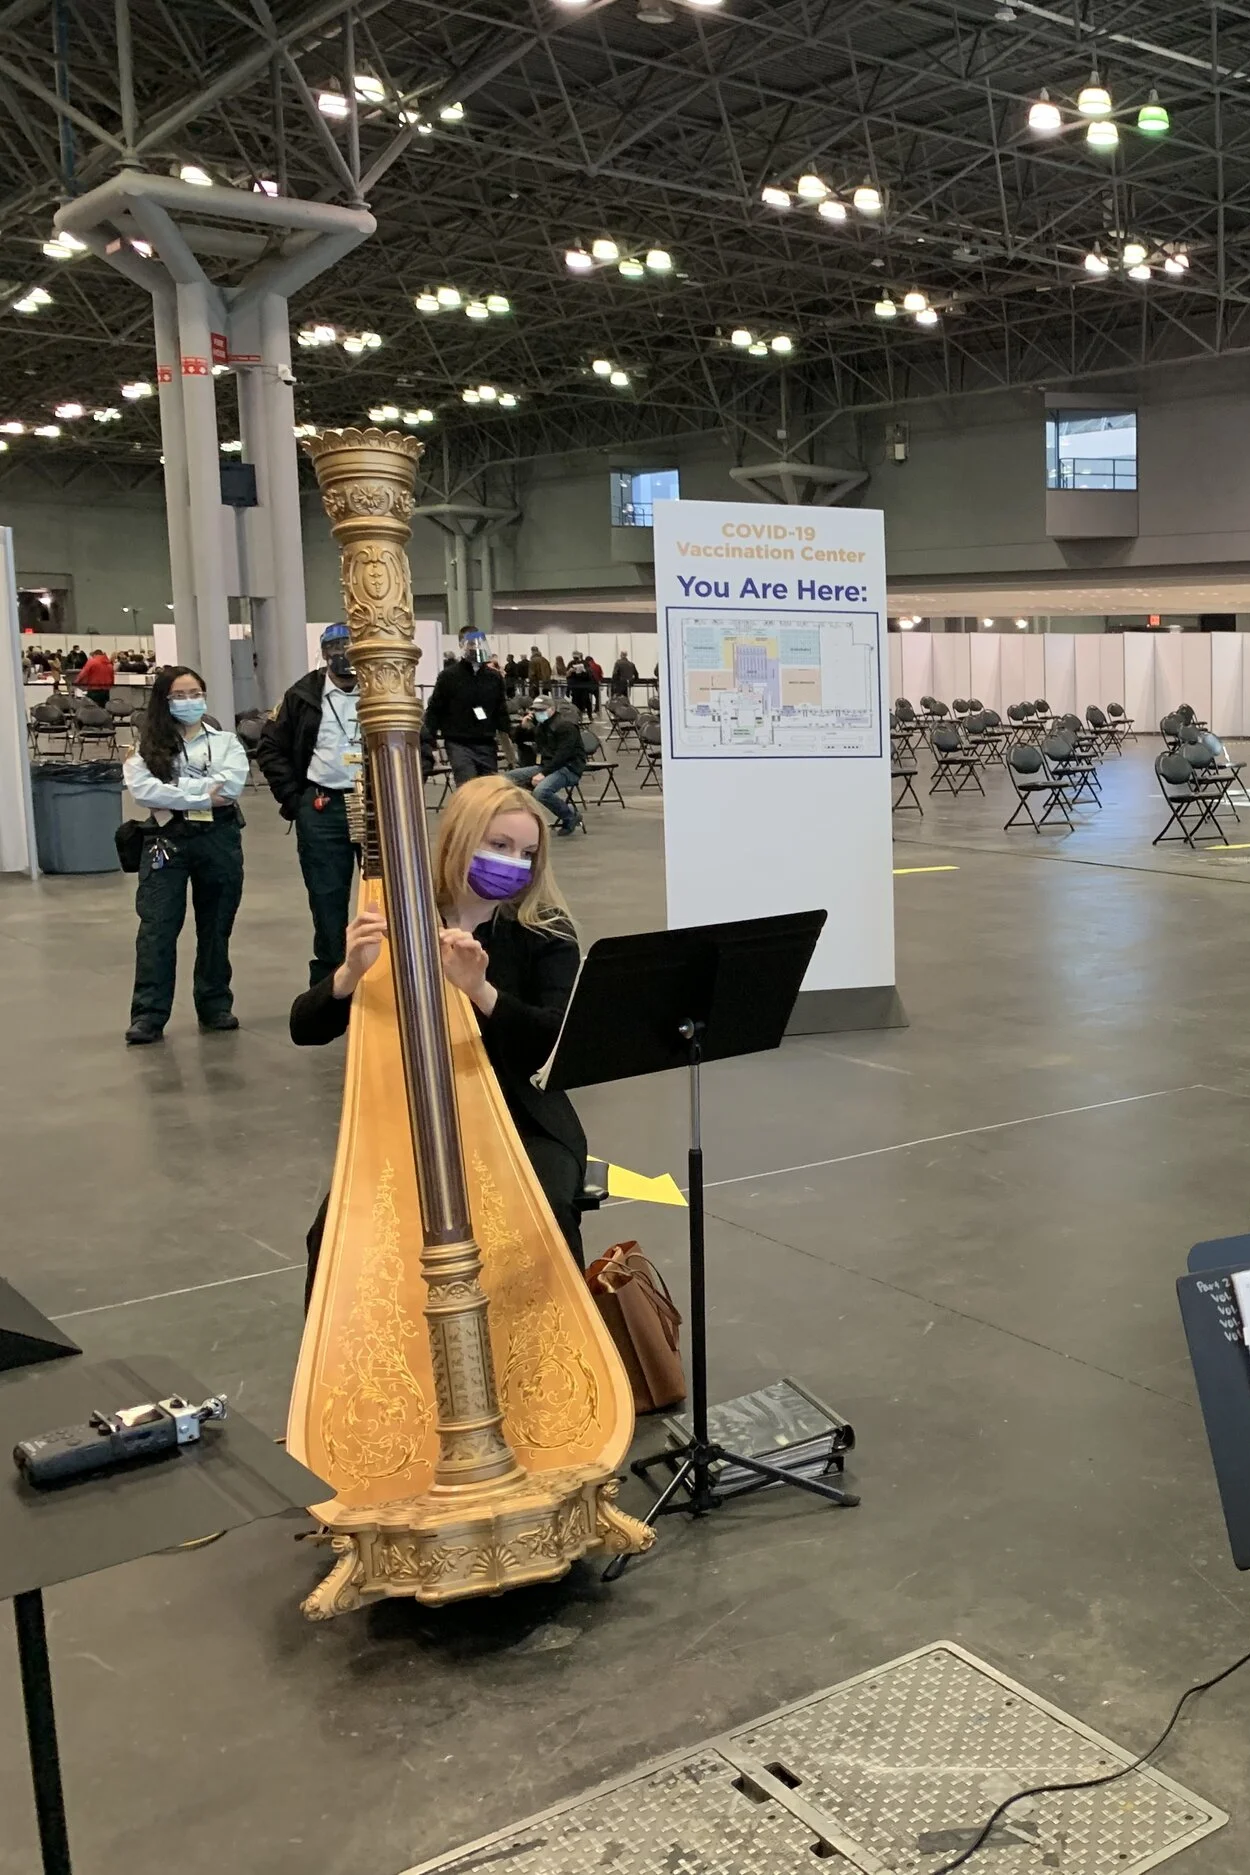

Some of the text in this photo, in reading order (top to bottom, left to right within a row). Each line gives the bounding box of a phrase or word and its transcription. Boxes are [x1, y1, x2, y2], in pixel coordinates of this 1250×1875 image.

[722, 522, 816, 541] COVID-19
[676, 541, 866, 563] Vaccination Center
[676, 575, 867, 602] You Are Here:
